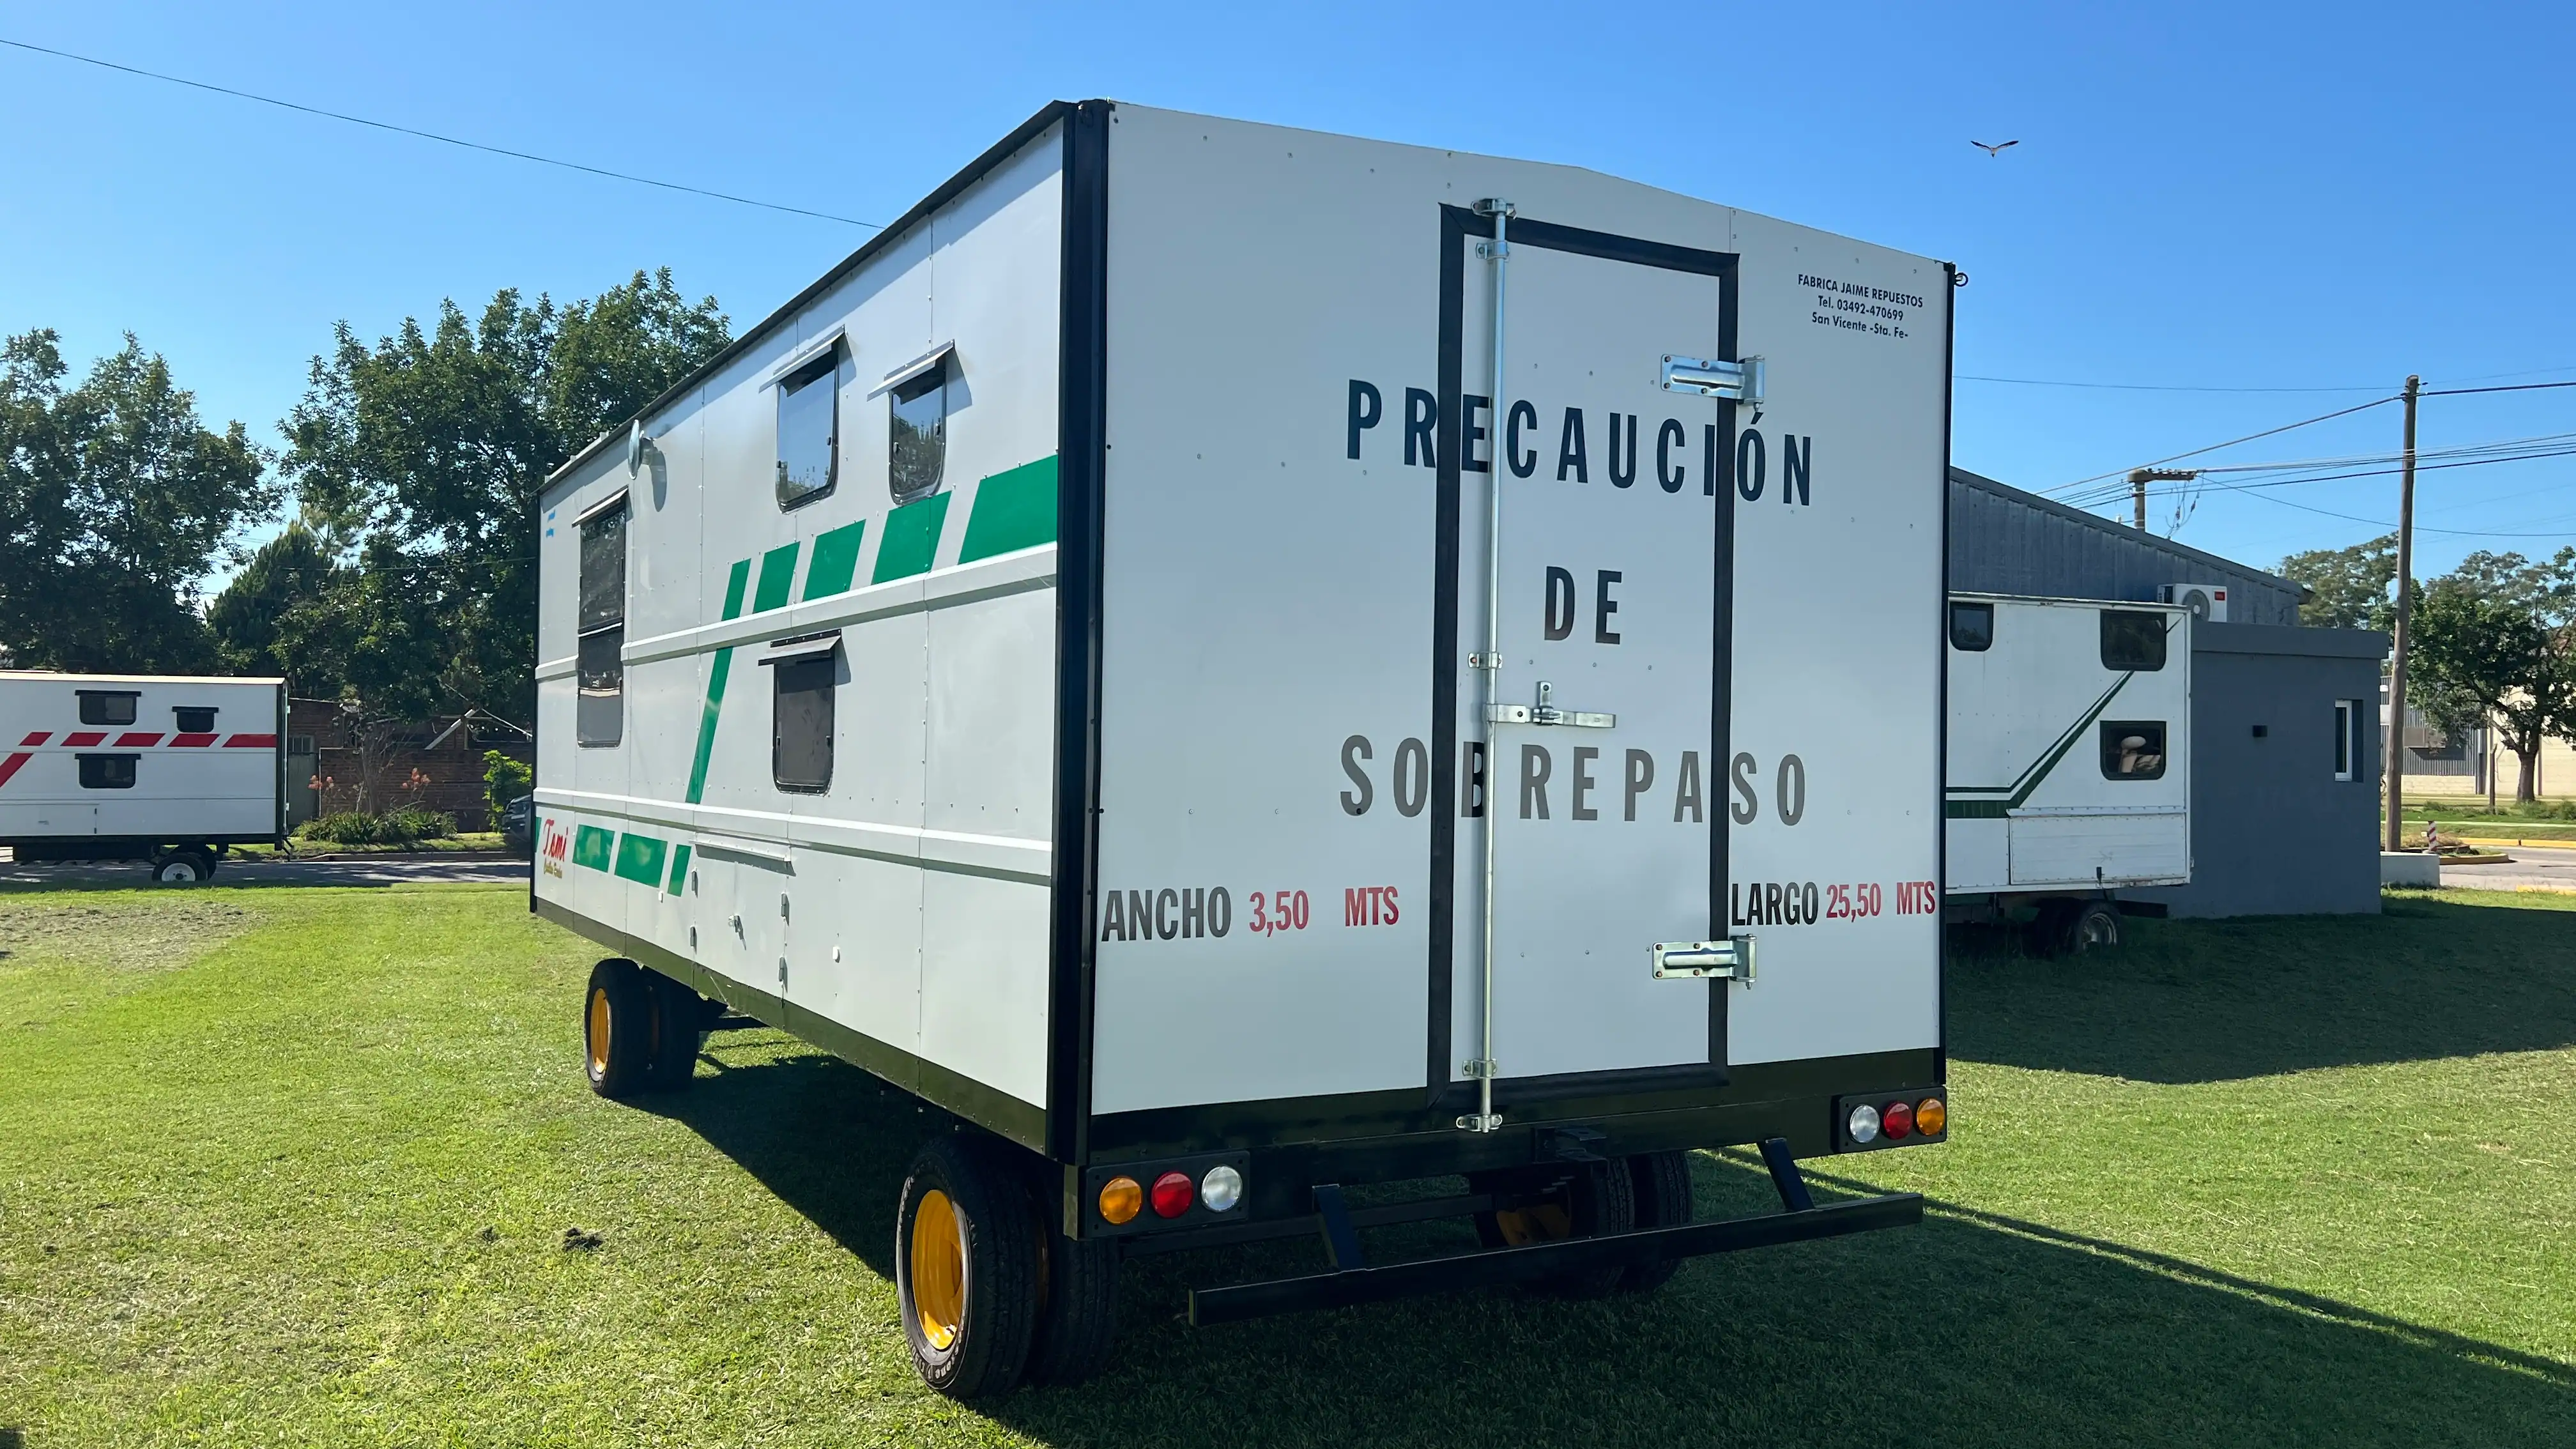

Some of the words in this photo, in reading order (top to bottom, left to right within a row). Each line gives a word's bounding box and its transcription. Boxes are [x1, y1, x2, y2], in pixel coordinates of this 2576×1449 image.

[1798, 274, 1838, 293] FABRICA
[1841, 282, 1869, 298] JAIME
[1872, 288, 1923, 308] REPUESTOS
[1818, 295, 1834, 309] Tel.
[1837, 299, 1903, 321] 03492-470699
[1812, 312, 1829, 325] San
[1832, 315, 1866, 332] Vicente
[1346, 379, 1811, 506] PRECAUCIÓN
[1544, 565, 1622, 645] DE
[1340, 735, 1805, 826] SOBREPASO
[1101, 886, 1231, 942] ANCHO
[1249, 890, 1310, 937] 3,50
[1344, 885, 1399, 927] MTS
[1731, 882, 1819, 926] LARGO
[1826, 883, 1882, 923] 25,50
[1896, 880, 1936, 916] MTS
